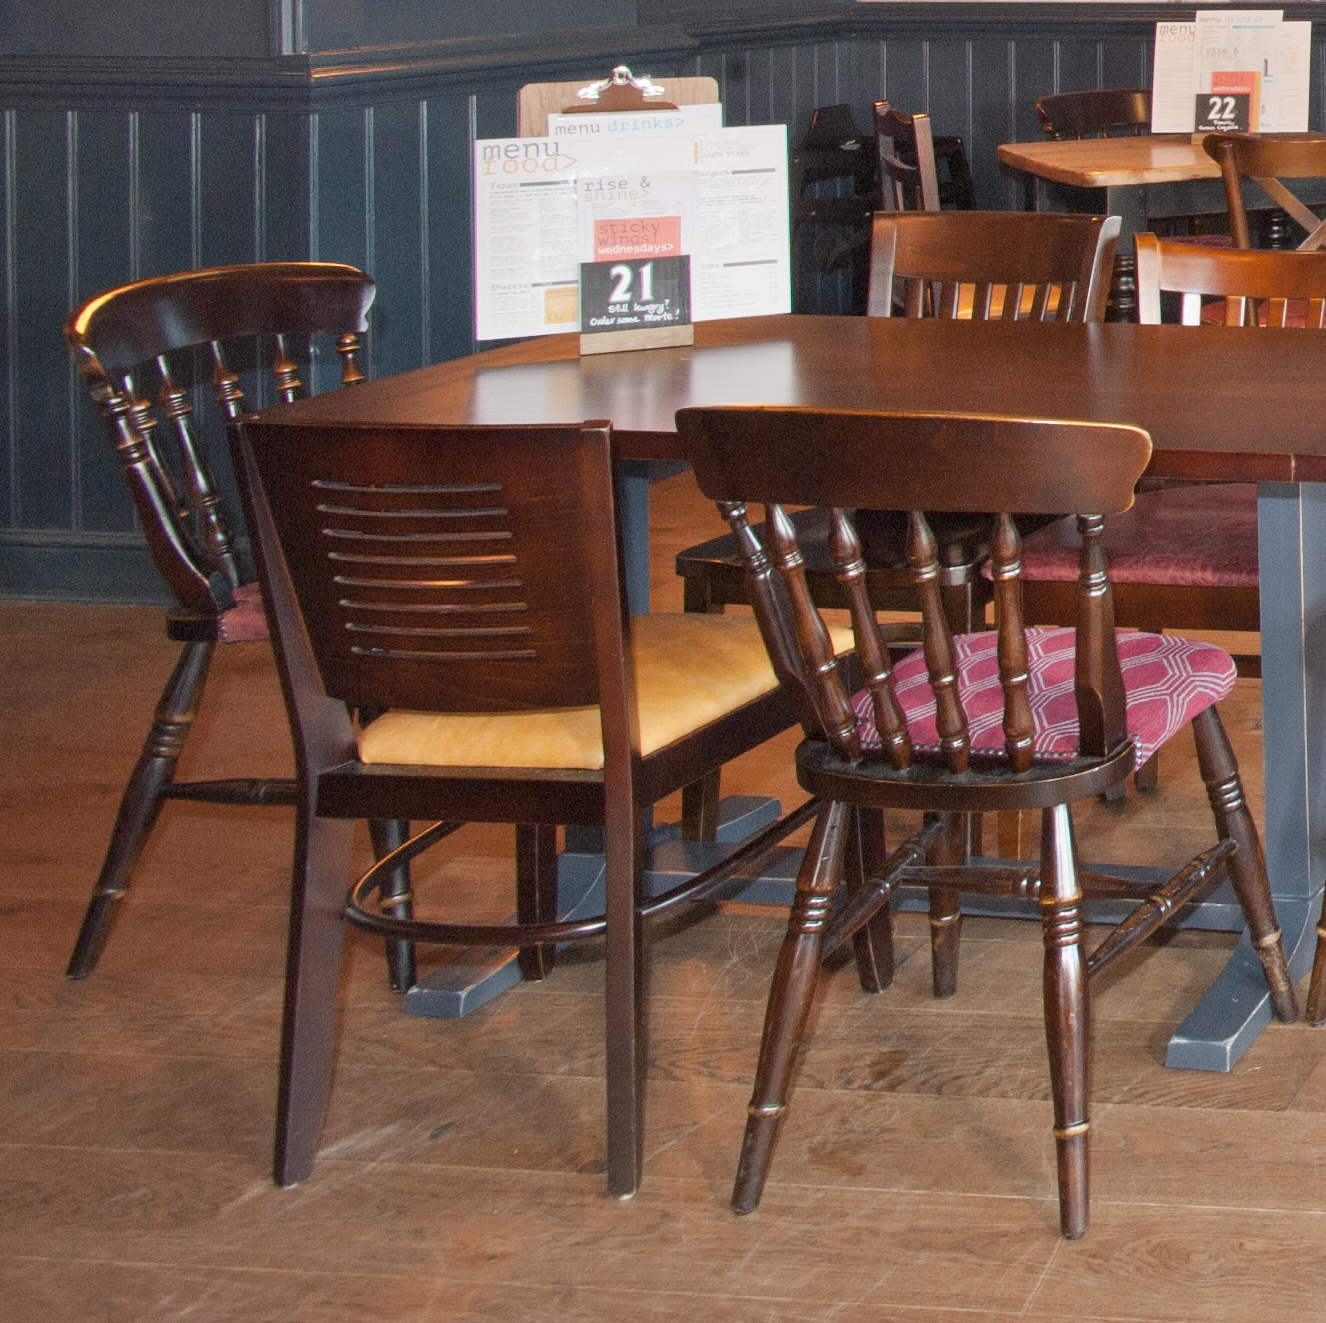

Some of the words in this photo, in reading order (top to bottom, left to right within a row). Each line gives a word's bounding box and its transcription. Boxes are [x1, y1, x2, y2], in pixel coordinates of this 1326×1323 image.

[1208, 96, 1235, 120] 22
[555, 123, 601, 135] menu
[483, 141, 562, 160] menu
[584, 179, 628, 192] rise
[640, 176, 651, 188] &
[599, 221, 660, 236] sticky
[608, 261, 655, 303] 21
